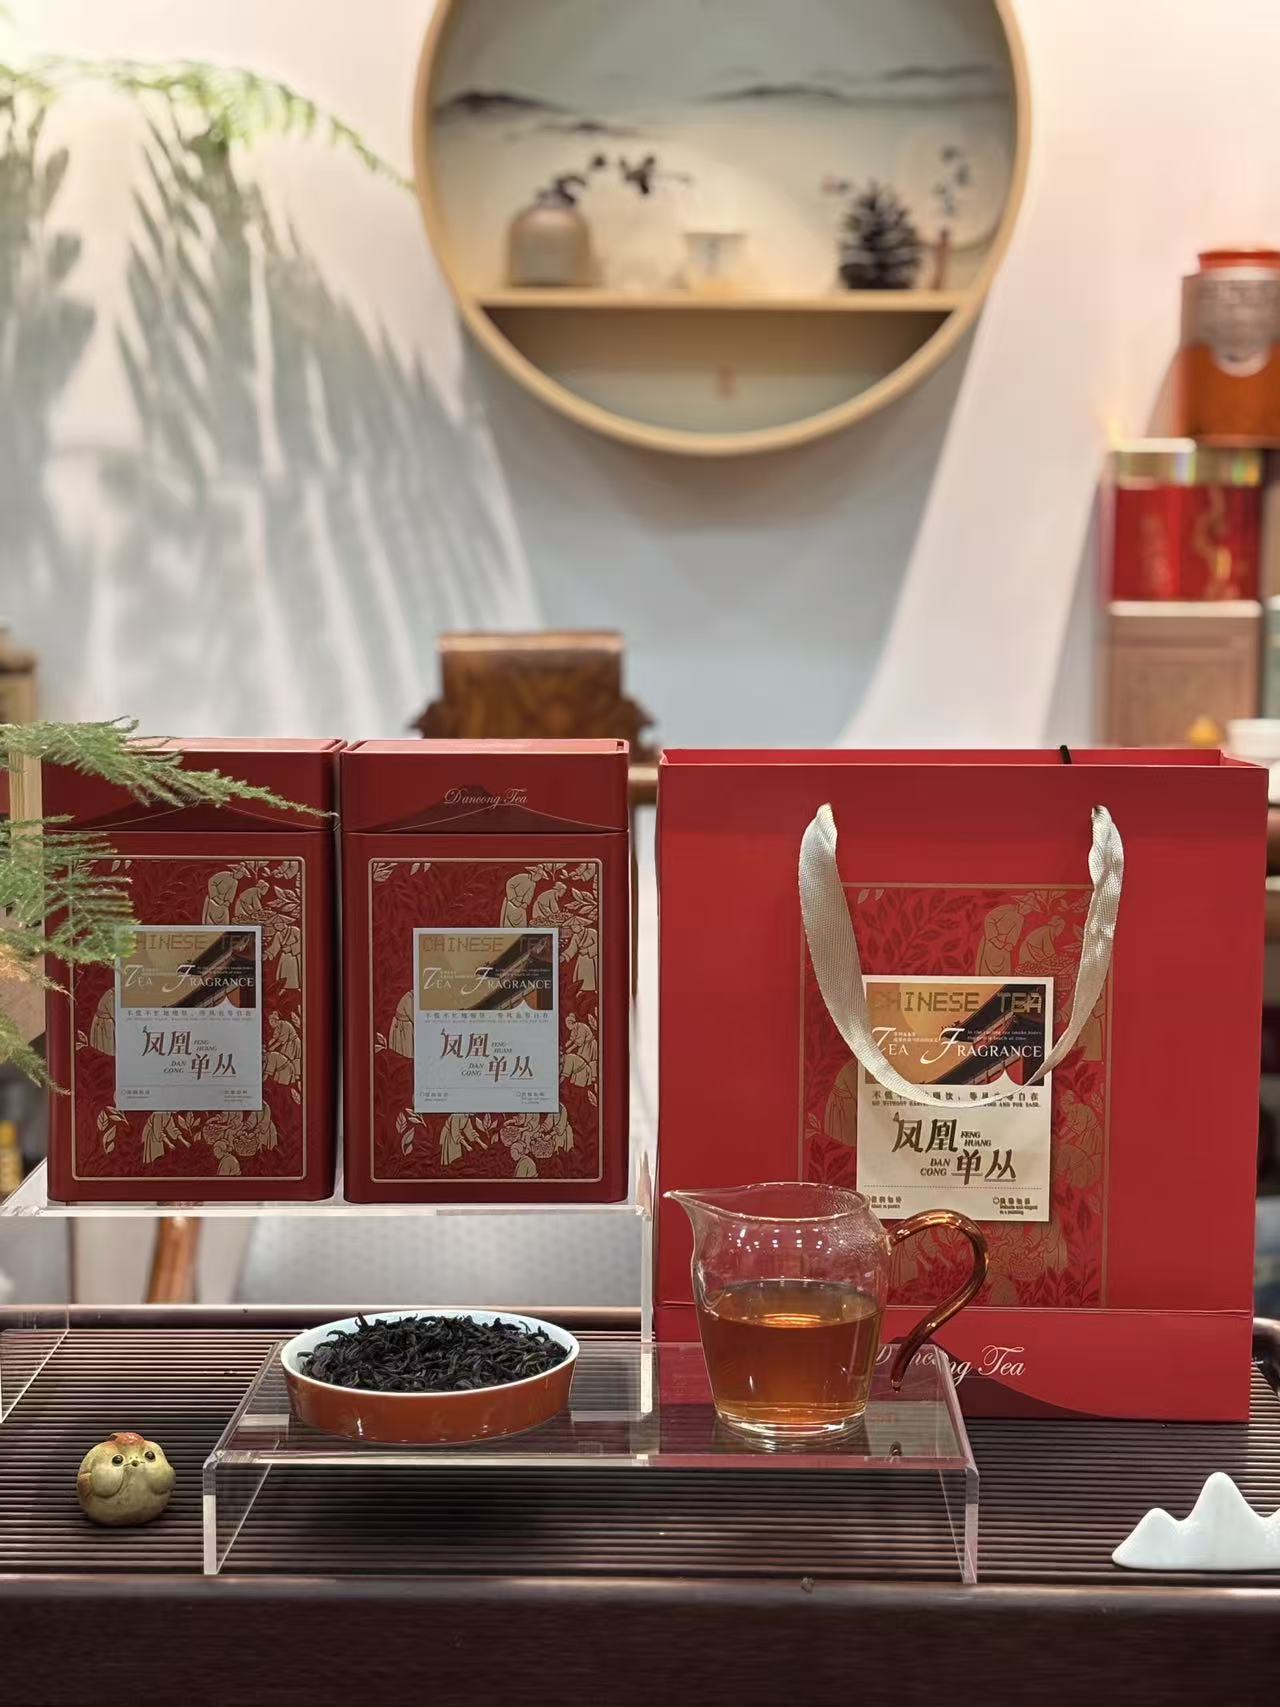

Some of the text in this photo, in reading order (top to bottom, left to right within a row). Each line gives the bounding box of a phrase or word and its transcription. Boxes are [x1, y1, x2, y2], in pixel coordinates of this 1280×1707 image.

[444, 787, 528, 809] Dancong Tea
[422, 936, 505, 953] CHINESE
[123, 964, 254, 993] TEA FRAGRANCE
[423, 967, 552, 995] TEA FRAGRANCE
[142, 1025, 193, 1057] 凤凰
[440, 1027, 490, 1059] 凤凰
[919, 1027, 1043, 1065] FRAGRANCE
[163, 1066, 184, 1074] CONG
[190, 1053, 237, 1080] 单丛
[460, 1069, 482, 1077] CONG
[488, 1055, 534, 1083] 单丛
[891, 1111, 959, 1153] 凤凰
[960, 1130, 981, 1139] FENG
[963, 1139, 992, 1147] HUANG
[919, 1167, 948, 1177] CONG
[930, 1158, 951, 1167] DAN
[956, 1148, 1017, 1185] 单丛
[977, 1344, 1026, 1377] Tea
